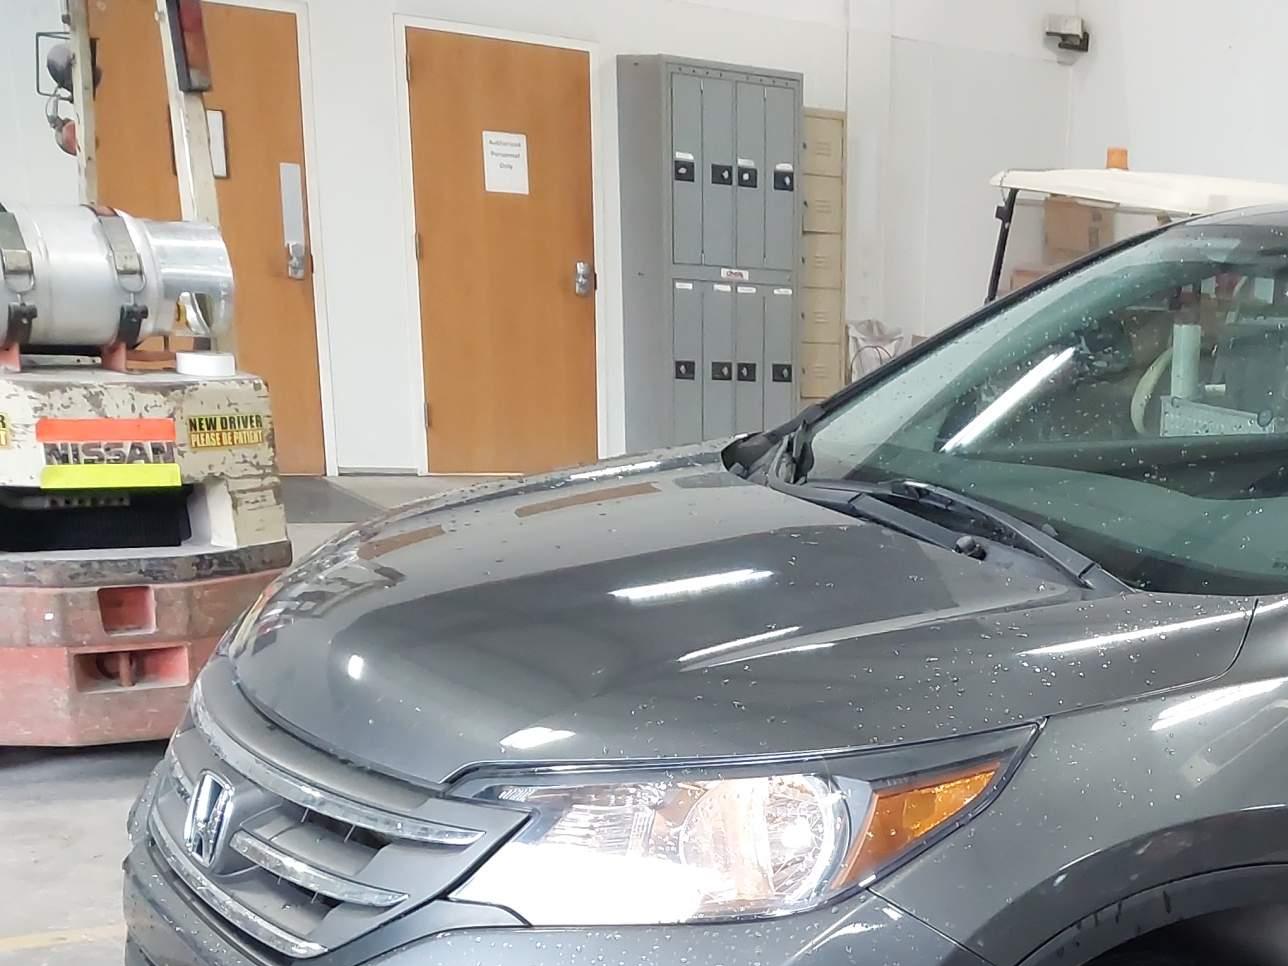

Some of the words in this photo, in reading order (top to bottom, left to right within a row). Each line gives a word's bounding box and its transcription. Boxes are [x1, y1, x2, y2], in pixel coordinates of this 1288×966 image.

[189, 417, 217, 432] NEW
[220, 414, 263, 430] DRIVER
[191, 432, 220, 448] PLEASE
[221, 431, 233, 446] BE
[233, 430, 263, 445] PATIENT
[43, 441, 176, 465] NISSAN
